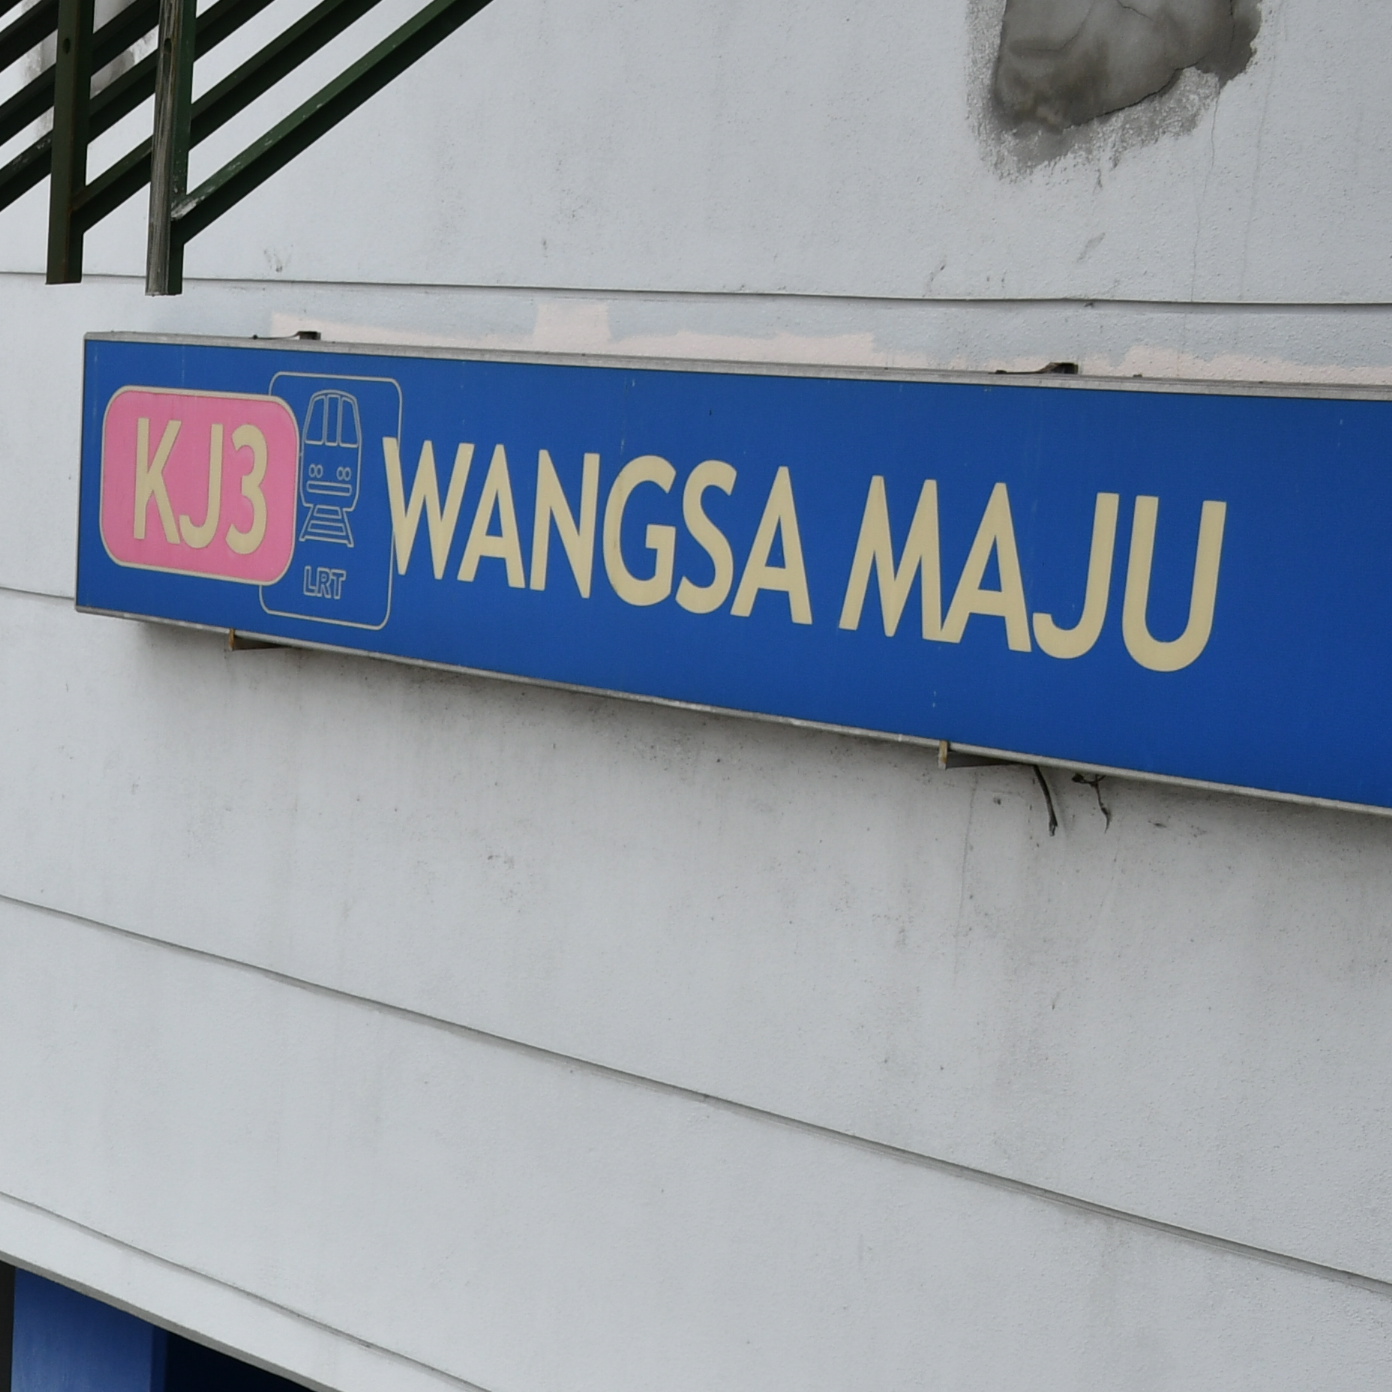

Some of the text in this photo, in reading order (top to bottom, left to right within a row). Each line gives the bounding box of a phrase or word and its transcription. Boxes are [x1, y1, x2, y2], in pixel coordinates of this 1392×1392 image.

[133, 417, 268, 555] KJ3
[383, 436, 1228, 673] WANGSA MAJU
[303, 565, 347, 600] LRT
